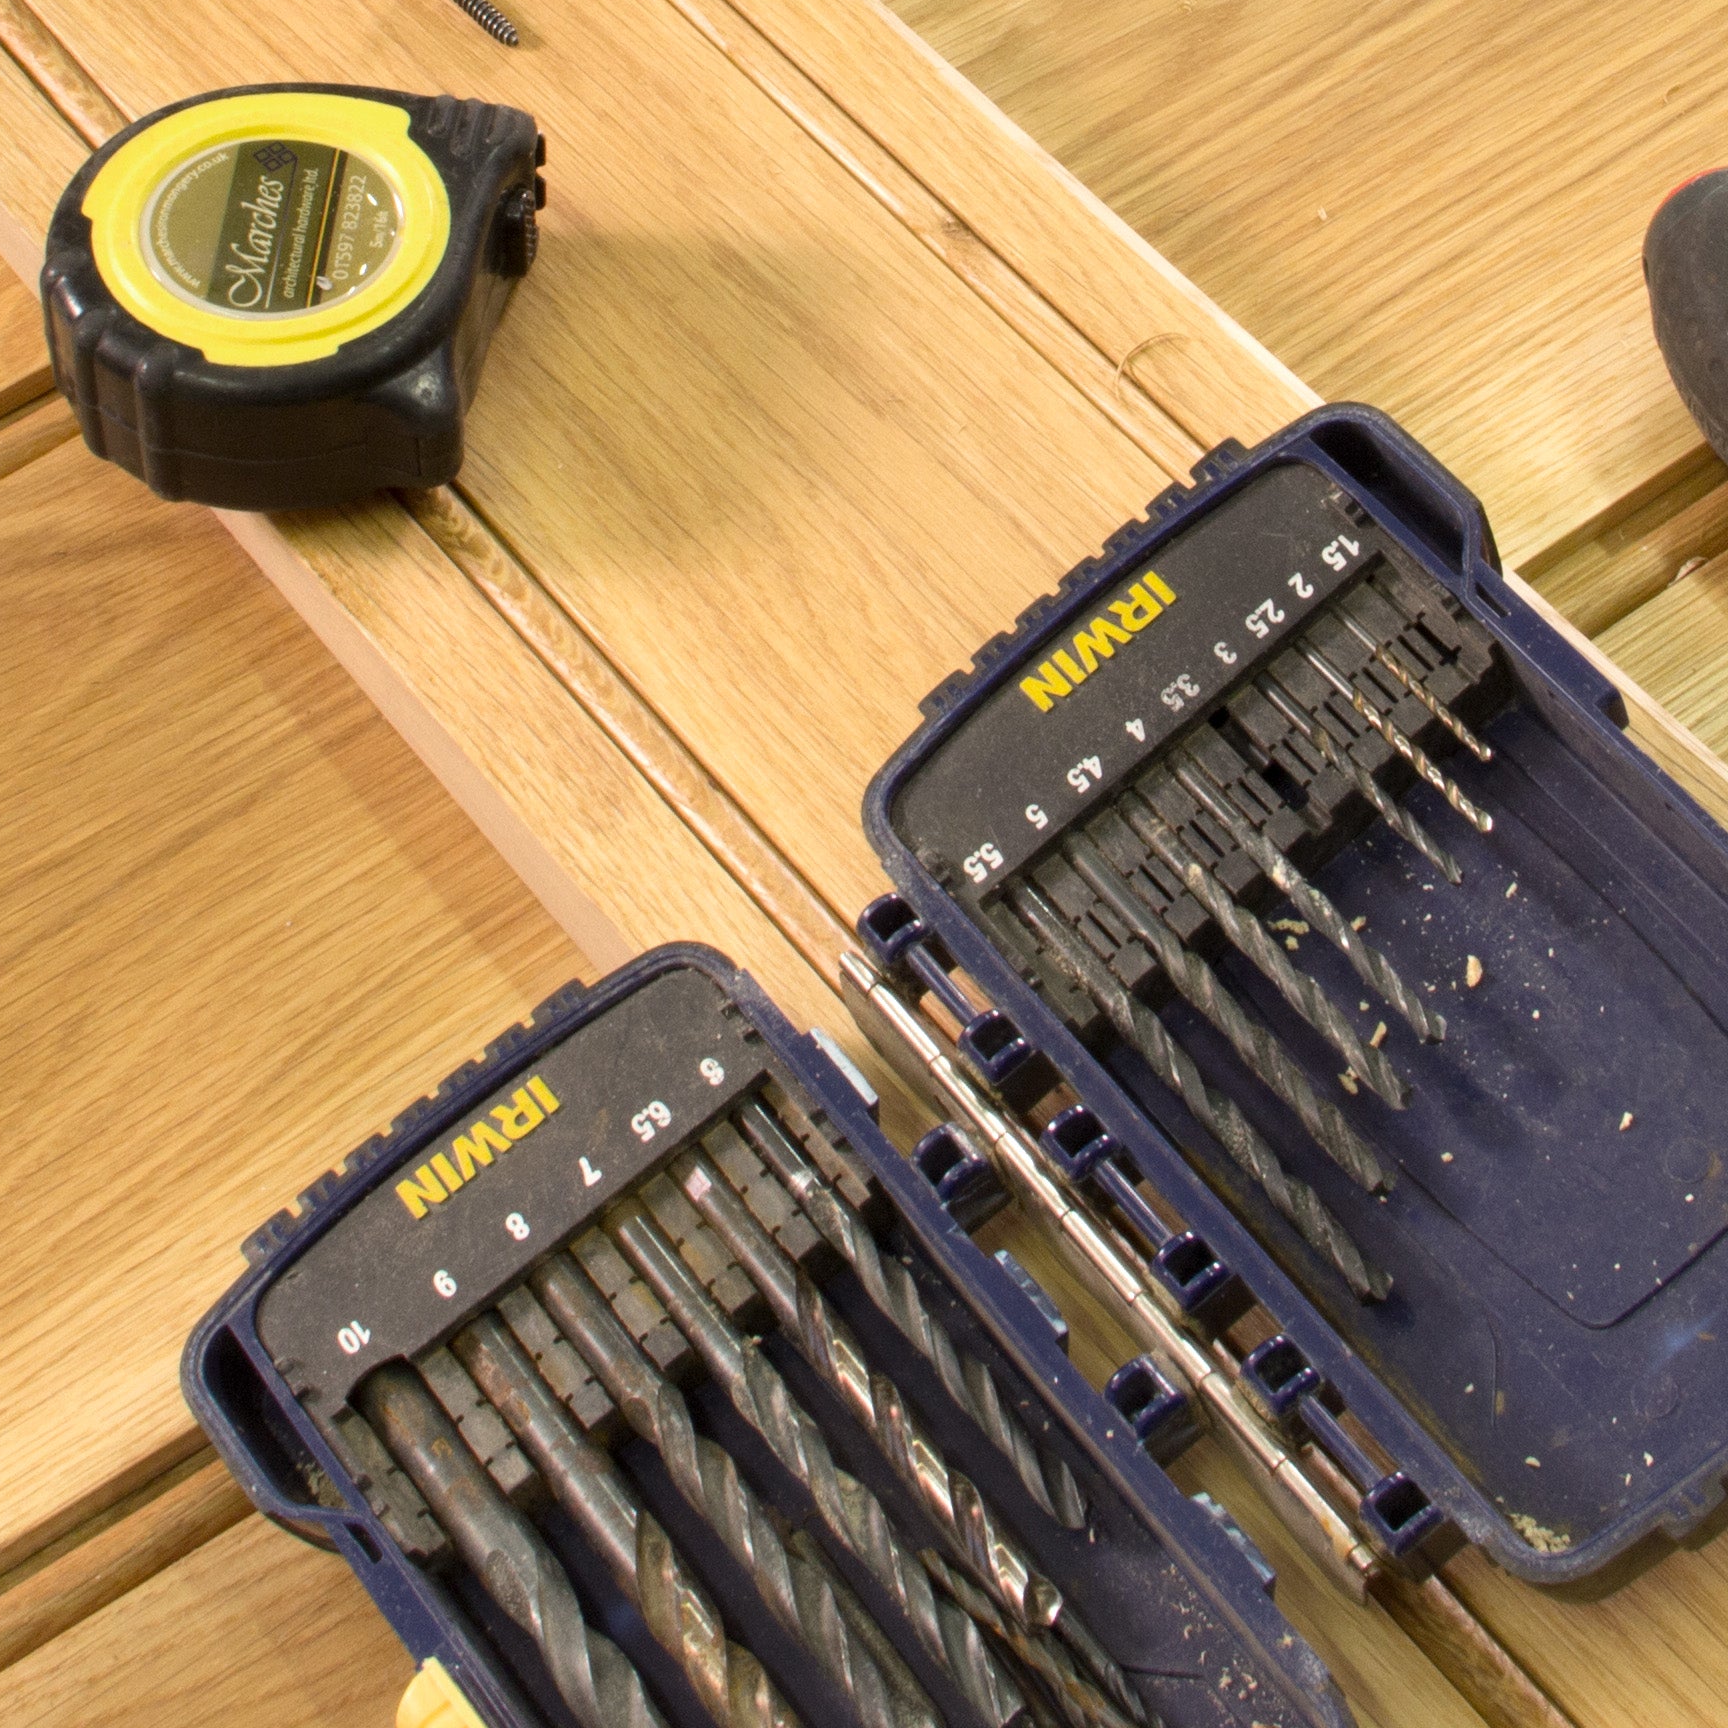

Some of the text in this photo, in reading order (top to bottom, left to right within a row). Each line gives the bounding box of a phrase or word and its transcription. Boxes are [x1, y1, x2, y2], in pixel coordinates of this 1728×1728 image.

[225, 175, 284, 308] Marches
[283, 236, 304, 300] architectural
[332, 174, 368, 281] 01597 823822
[963, 534, 1360, 883] 1.5 2 2.5 3 3.5 4 4.5 5 5.5
[1019, 570, 1177, 713] IRWIN
[337, 1057, 725, 1355] 6 6.5 7 8 9 10
[394, 1074, 561, 1221] IRWIN
